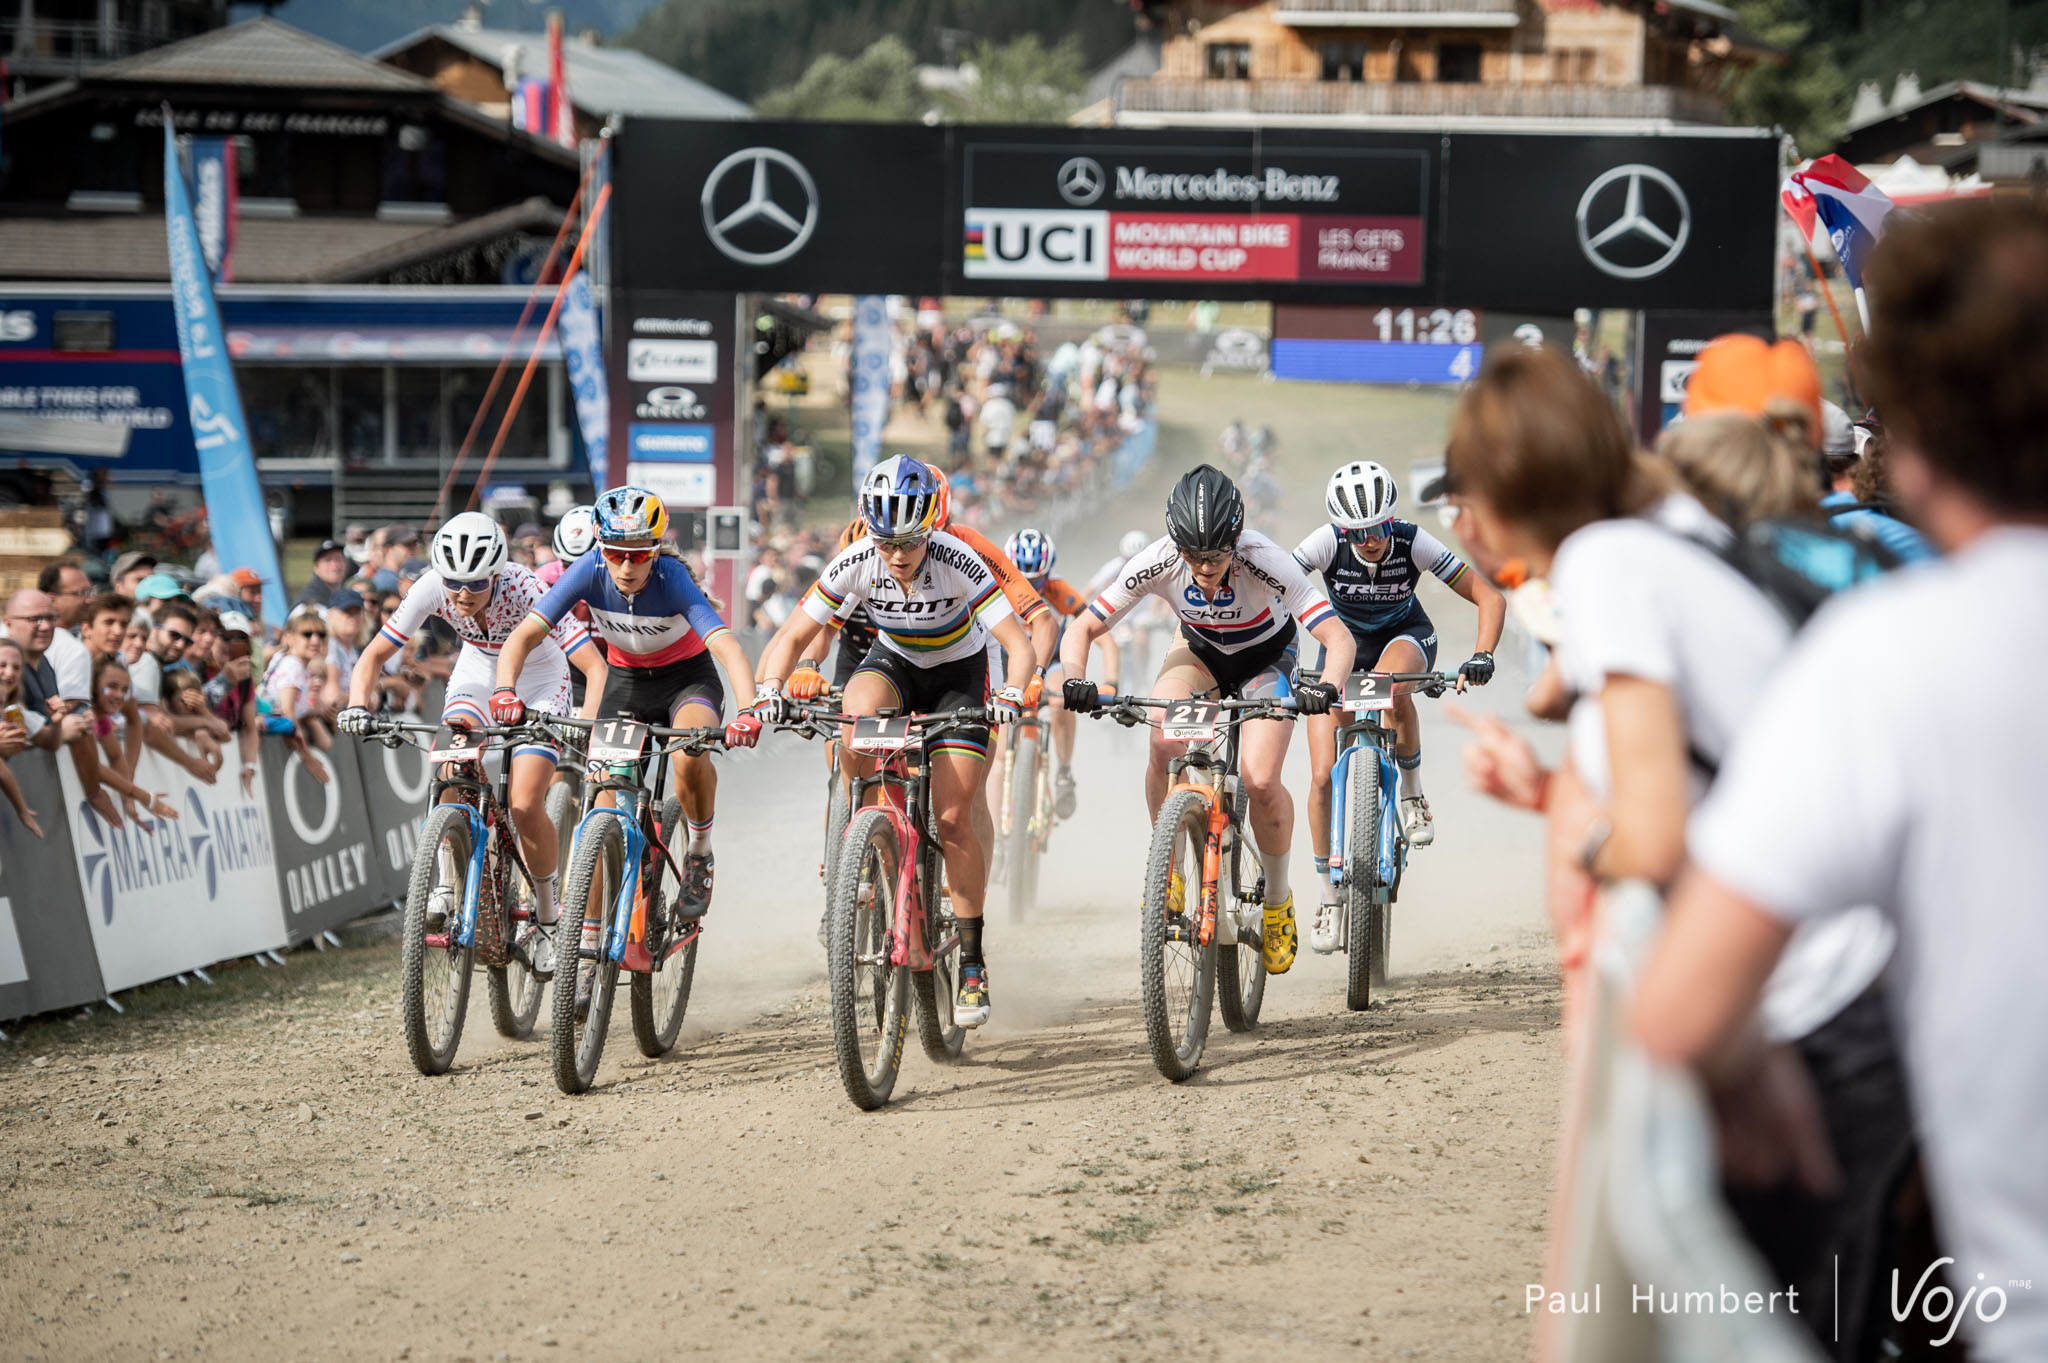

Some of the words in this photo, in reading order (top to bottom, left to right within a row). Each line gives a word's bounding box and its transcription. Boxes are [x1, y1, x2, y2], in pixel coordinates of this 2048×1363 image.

[1115, 166, 1340, 202] Mercedes-Benz
[993, 224, 1093, 263] UCI
[1114, 222, 1237, 248] MOUNTAIN
[1242, 224, 1290, 248] BIKE
[1318, 228, 1352, 250] LES
[1355, 229, 1405, 252] GETS
[1114, 248, 1194, 270] WORLD
[1199, 249, 1247, 272] CUP
[1318, 249, 1392, 272] FRANCE
[1372, 307, 1477, 344] 11:26
[1448, 347, 1474, 381] 4
[929, 541, 988, 586] ROCKSHOX
[1331, 578, 1412, 594] TREK
[867, 597, 960, 613] SCOTT
[1360, 678, 1376, 696] 2
[875, 718, 889, 734] 1
[1170, 705, 1208, 724] 21
[449, 733, 469, 750] 3
[602, 721, 637, 745] 11
[109, 815, 193, 893] MATRA
[286, 841, 368, 914] OAKLEY
